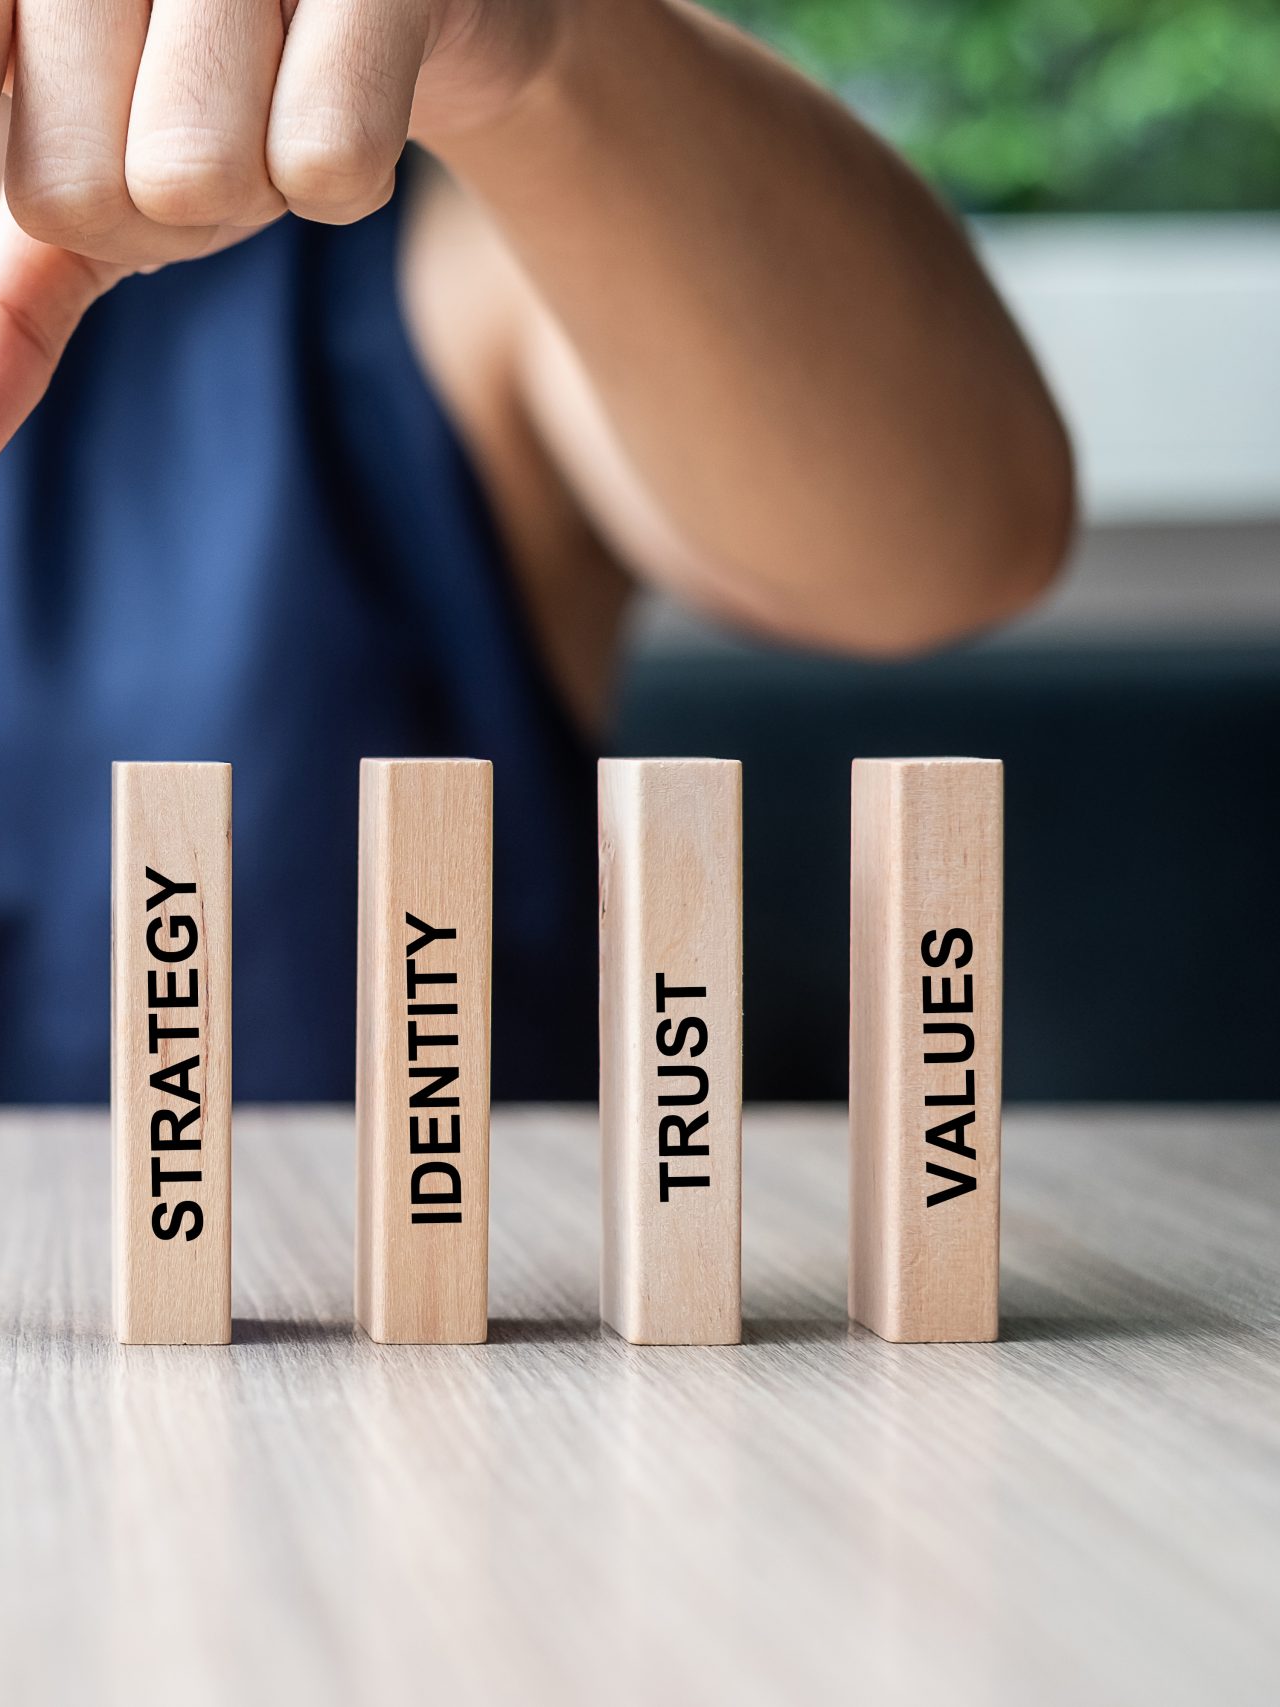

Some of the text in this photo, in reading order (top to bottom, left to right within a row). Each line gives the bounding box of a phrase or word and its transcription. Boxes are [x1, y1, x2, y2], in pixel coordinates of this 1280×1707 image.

[145, 865, 204, 1242] STRATEGY
[405, 911, 463, 1224] IDENTITY
[655, 972, 711, 1203] TRUST
[920, 927, 977, 1209] VALUES
